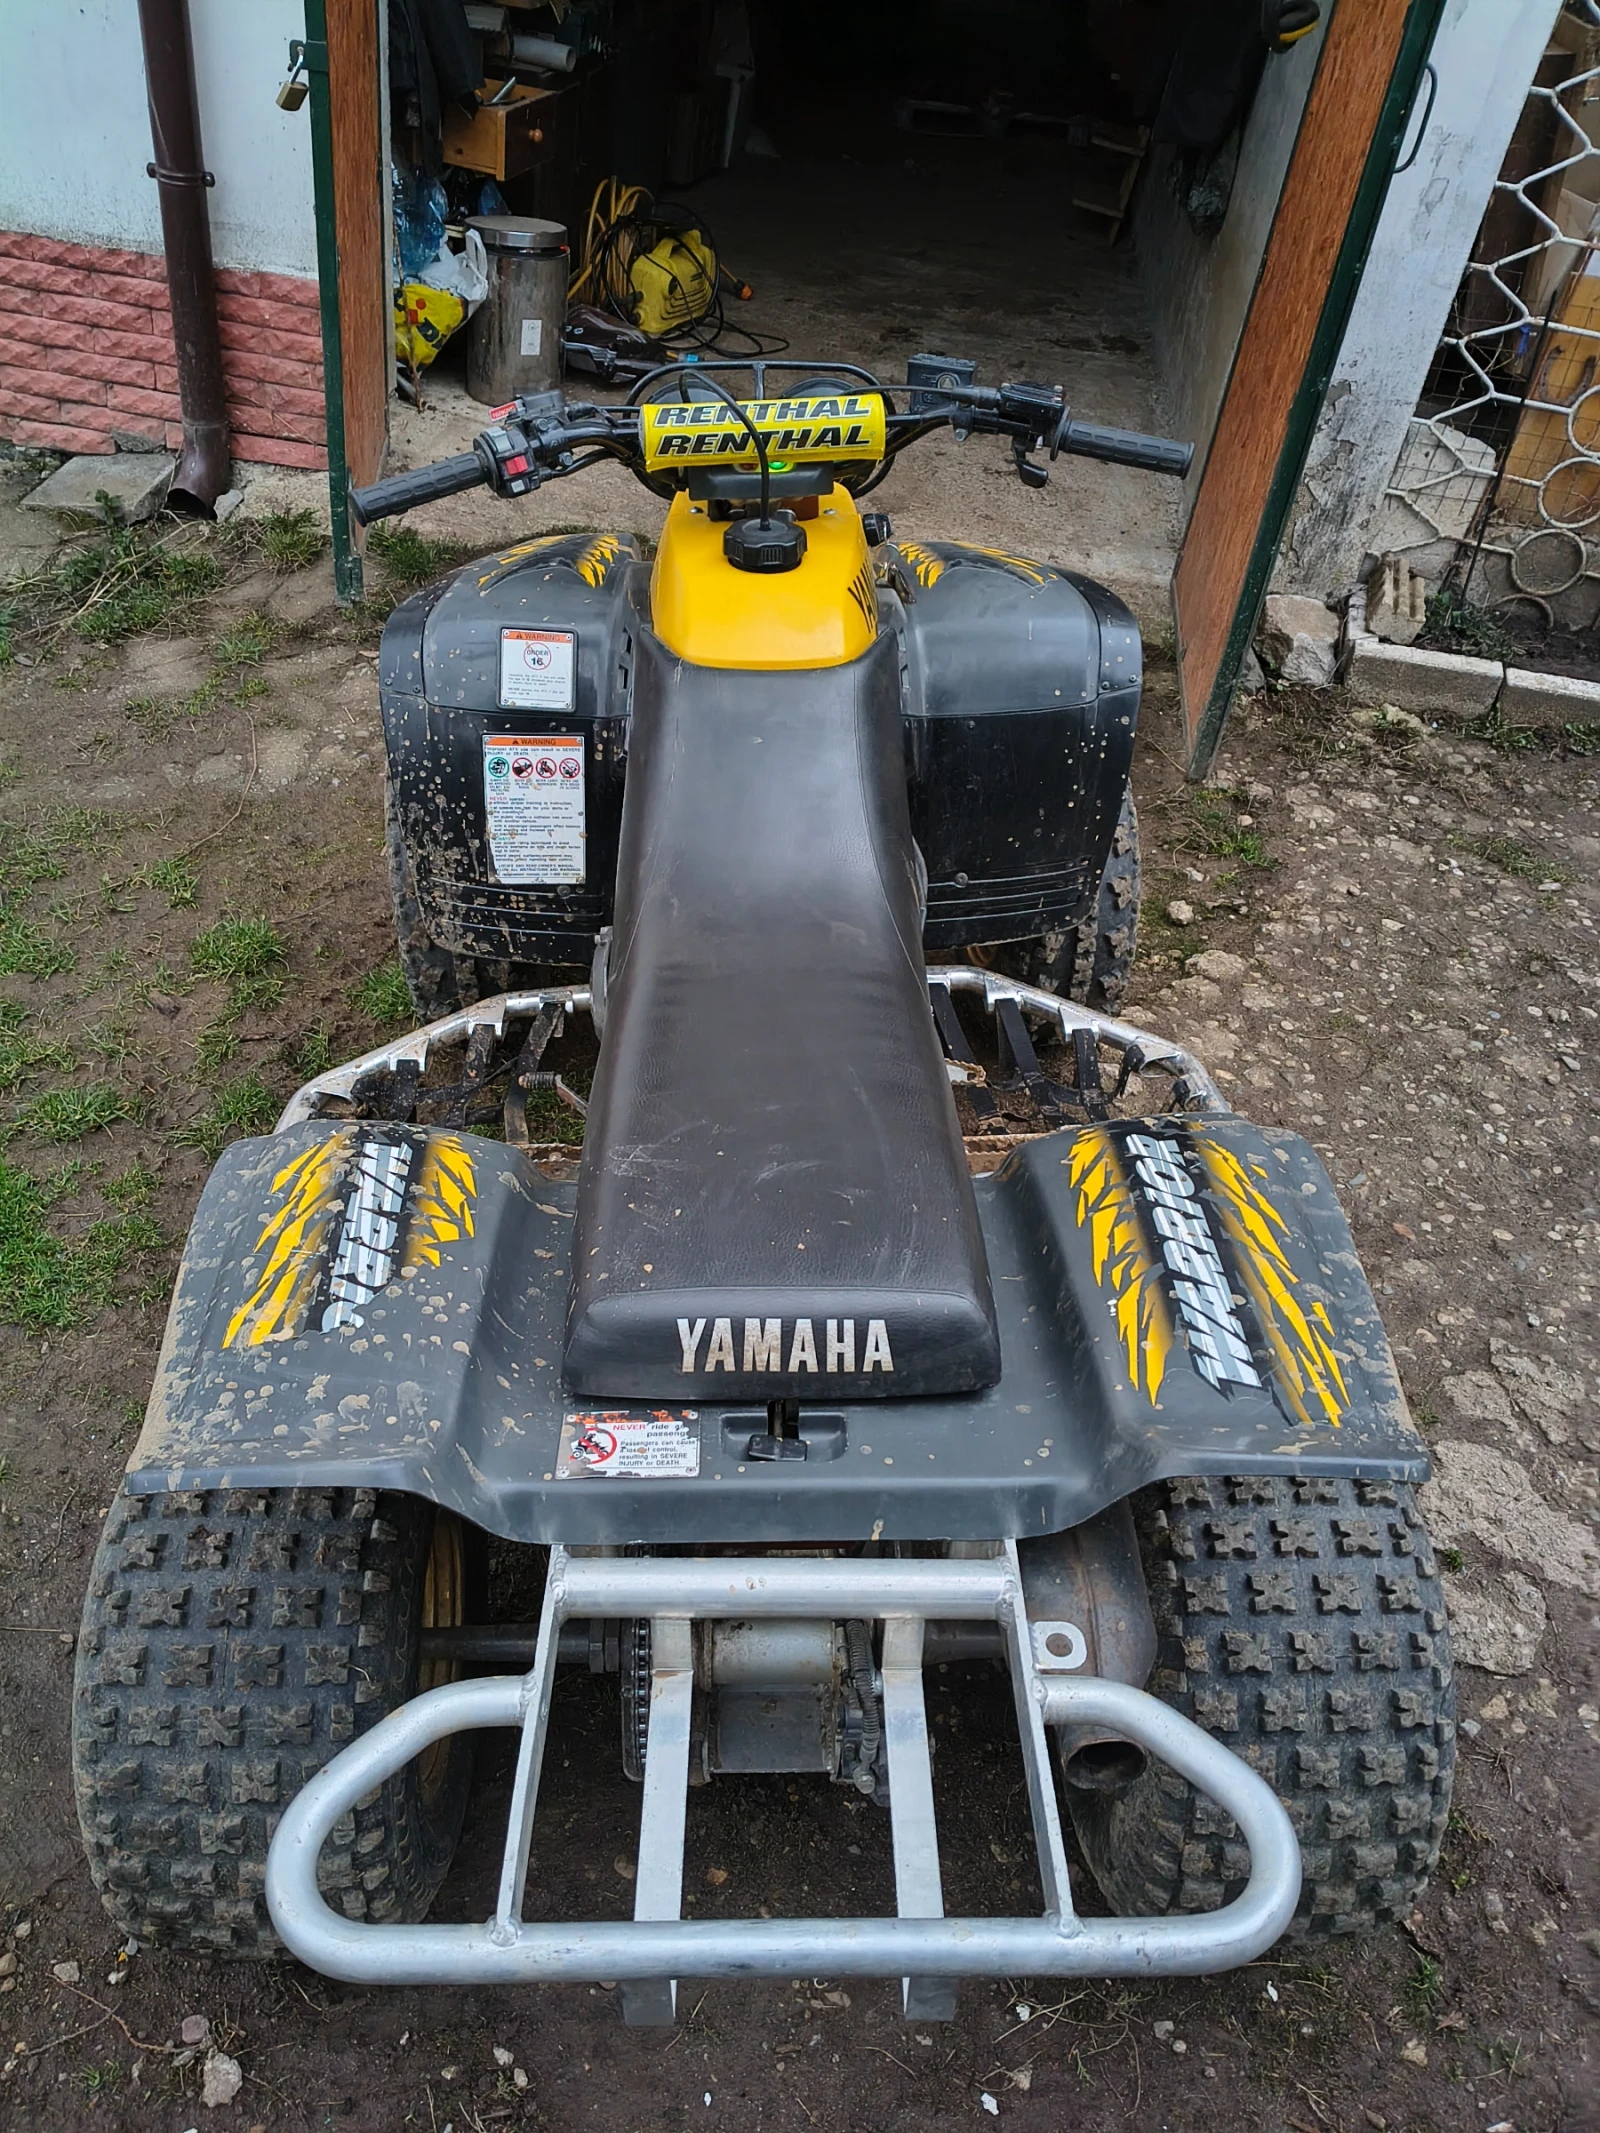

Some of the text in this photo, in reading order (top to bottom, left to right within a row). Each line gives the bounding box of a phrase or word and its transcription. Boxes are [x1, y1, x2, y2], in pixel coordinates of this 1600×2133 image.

[654, 398, 871, 427] RENTHAL
[655, 424, 872, 457] RENTHAL
[525, 633, 560, 641] WARNING
[531, 657, 543, 666] 16
[676, 1317, 895, 1373] YAMAHA
